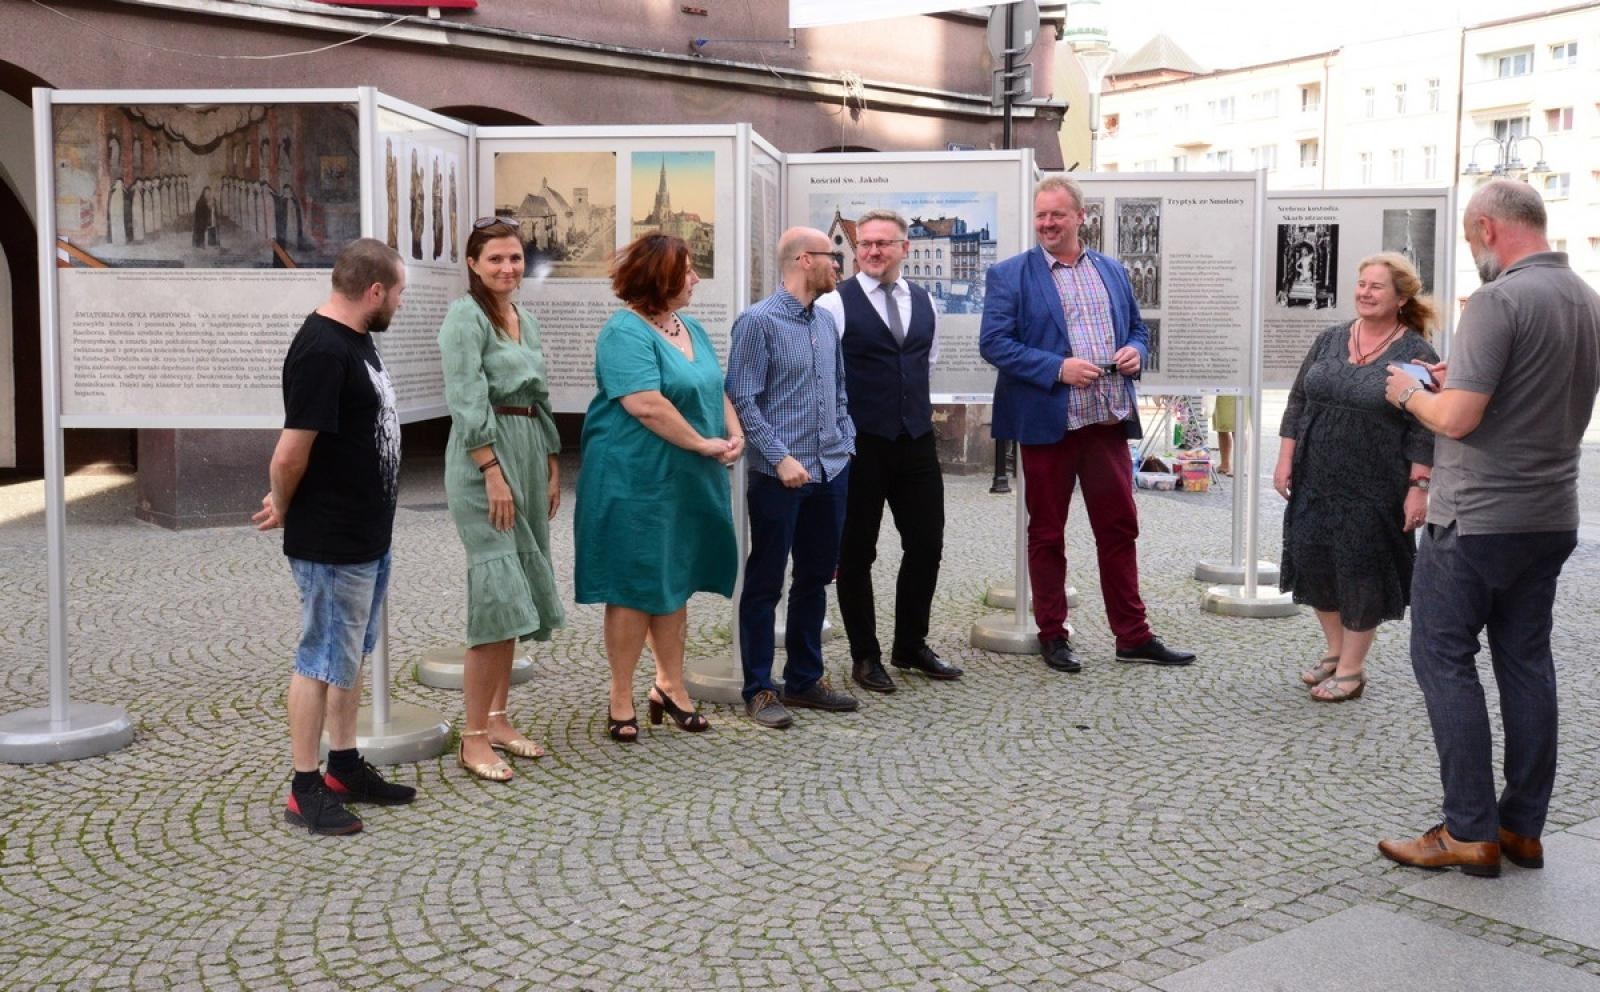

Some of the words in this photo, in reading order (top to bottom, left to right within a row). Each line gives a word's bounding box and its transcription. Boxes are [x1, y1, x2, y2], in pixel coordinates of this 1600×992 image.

[810, 176, 841, 185] Kościół
[842, 176, 857, 185] św.
[859, 175, 889, 184] Jakuba
[1167, 198, 1197, 206] Tryptyk
[1209, 197, 1244, 206] Smolnicy
